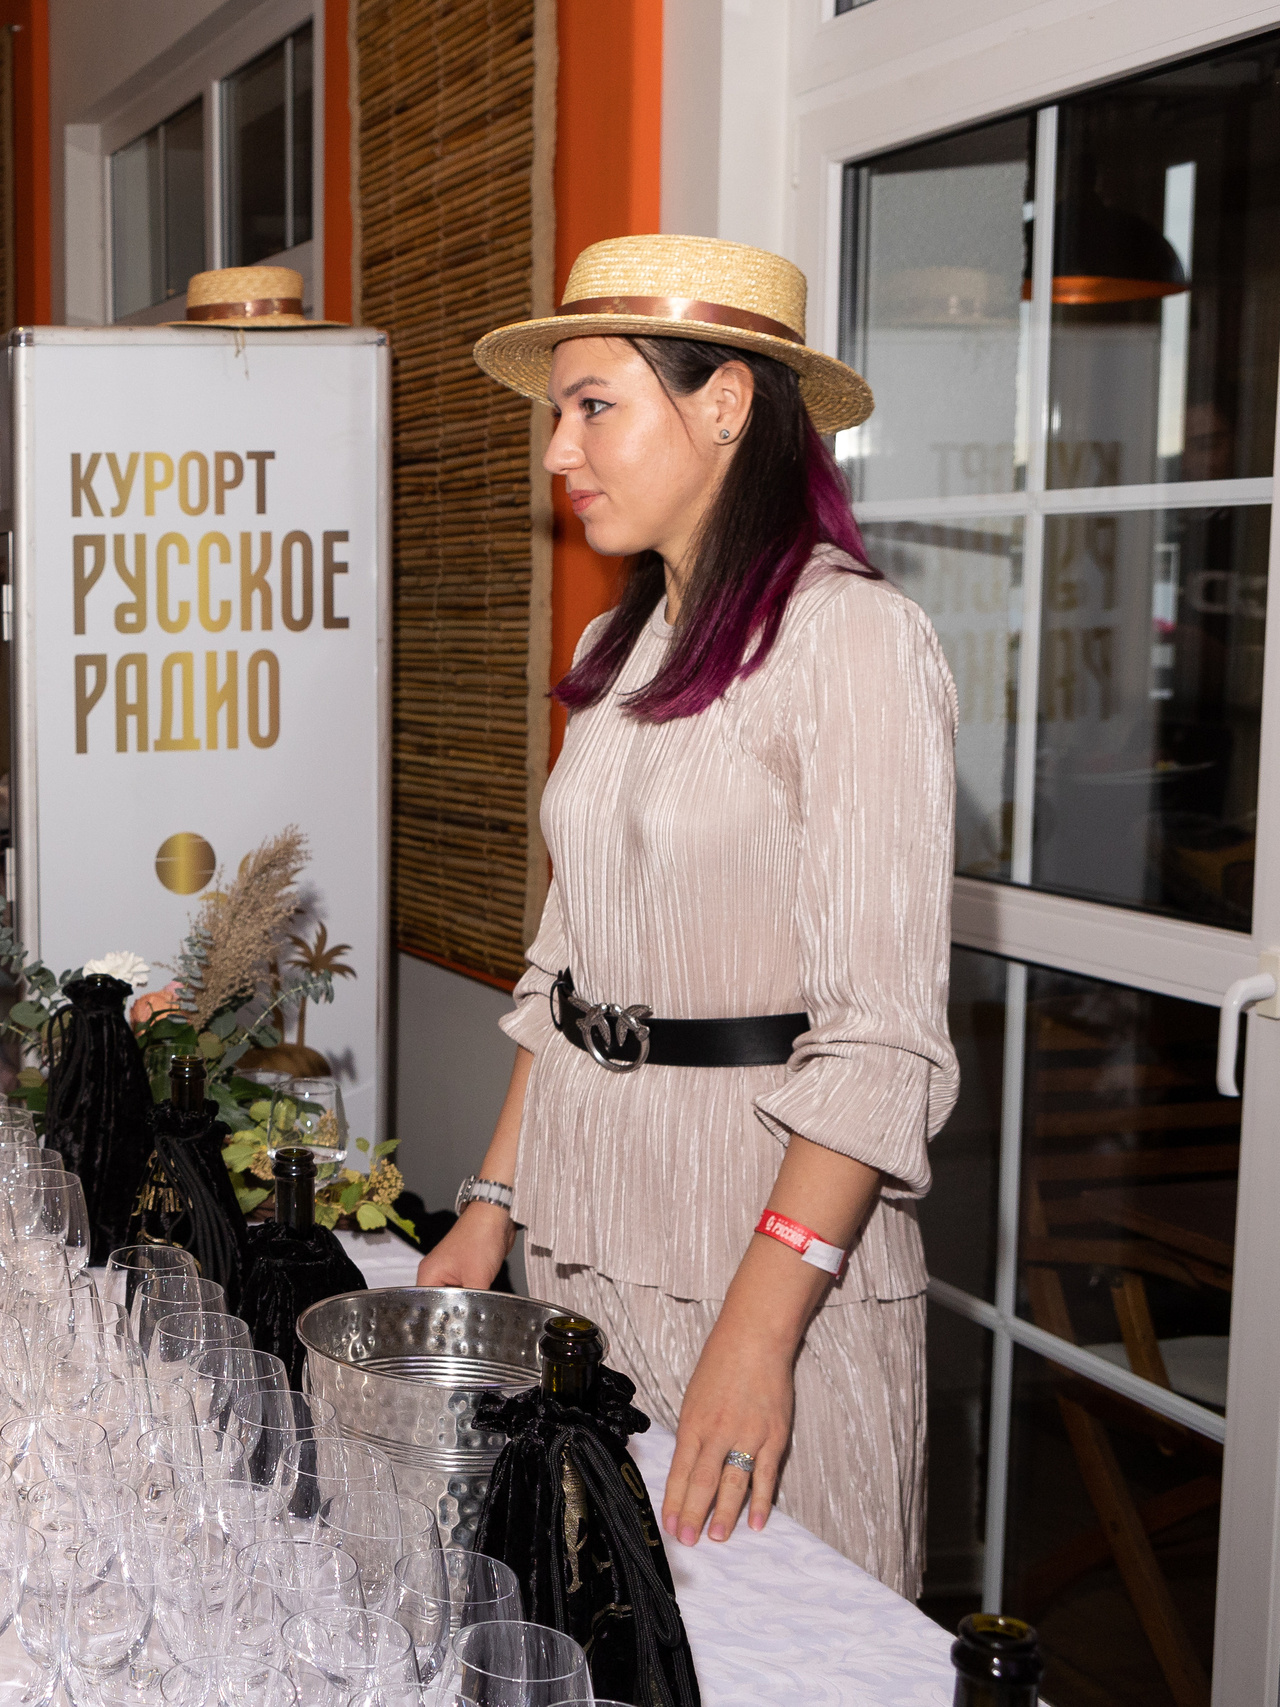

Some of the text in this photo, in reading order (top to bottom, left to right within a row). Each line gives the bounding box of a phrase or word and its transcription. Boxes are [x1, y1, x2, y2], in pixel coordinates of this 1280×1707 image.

[70, 450, 276, 517] КУРОРТ
[73, 530, 350, 636] РУССКОЕ
[74, 648, 280, 755] РАДИО
